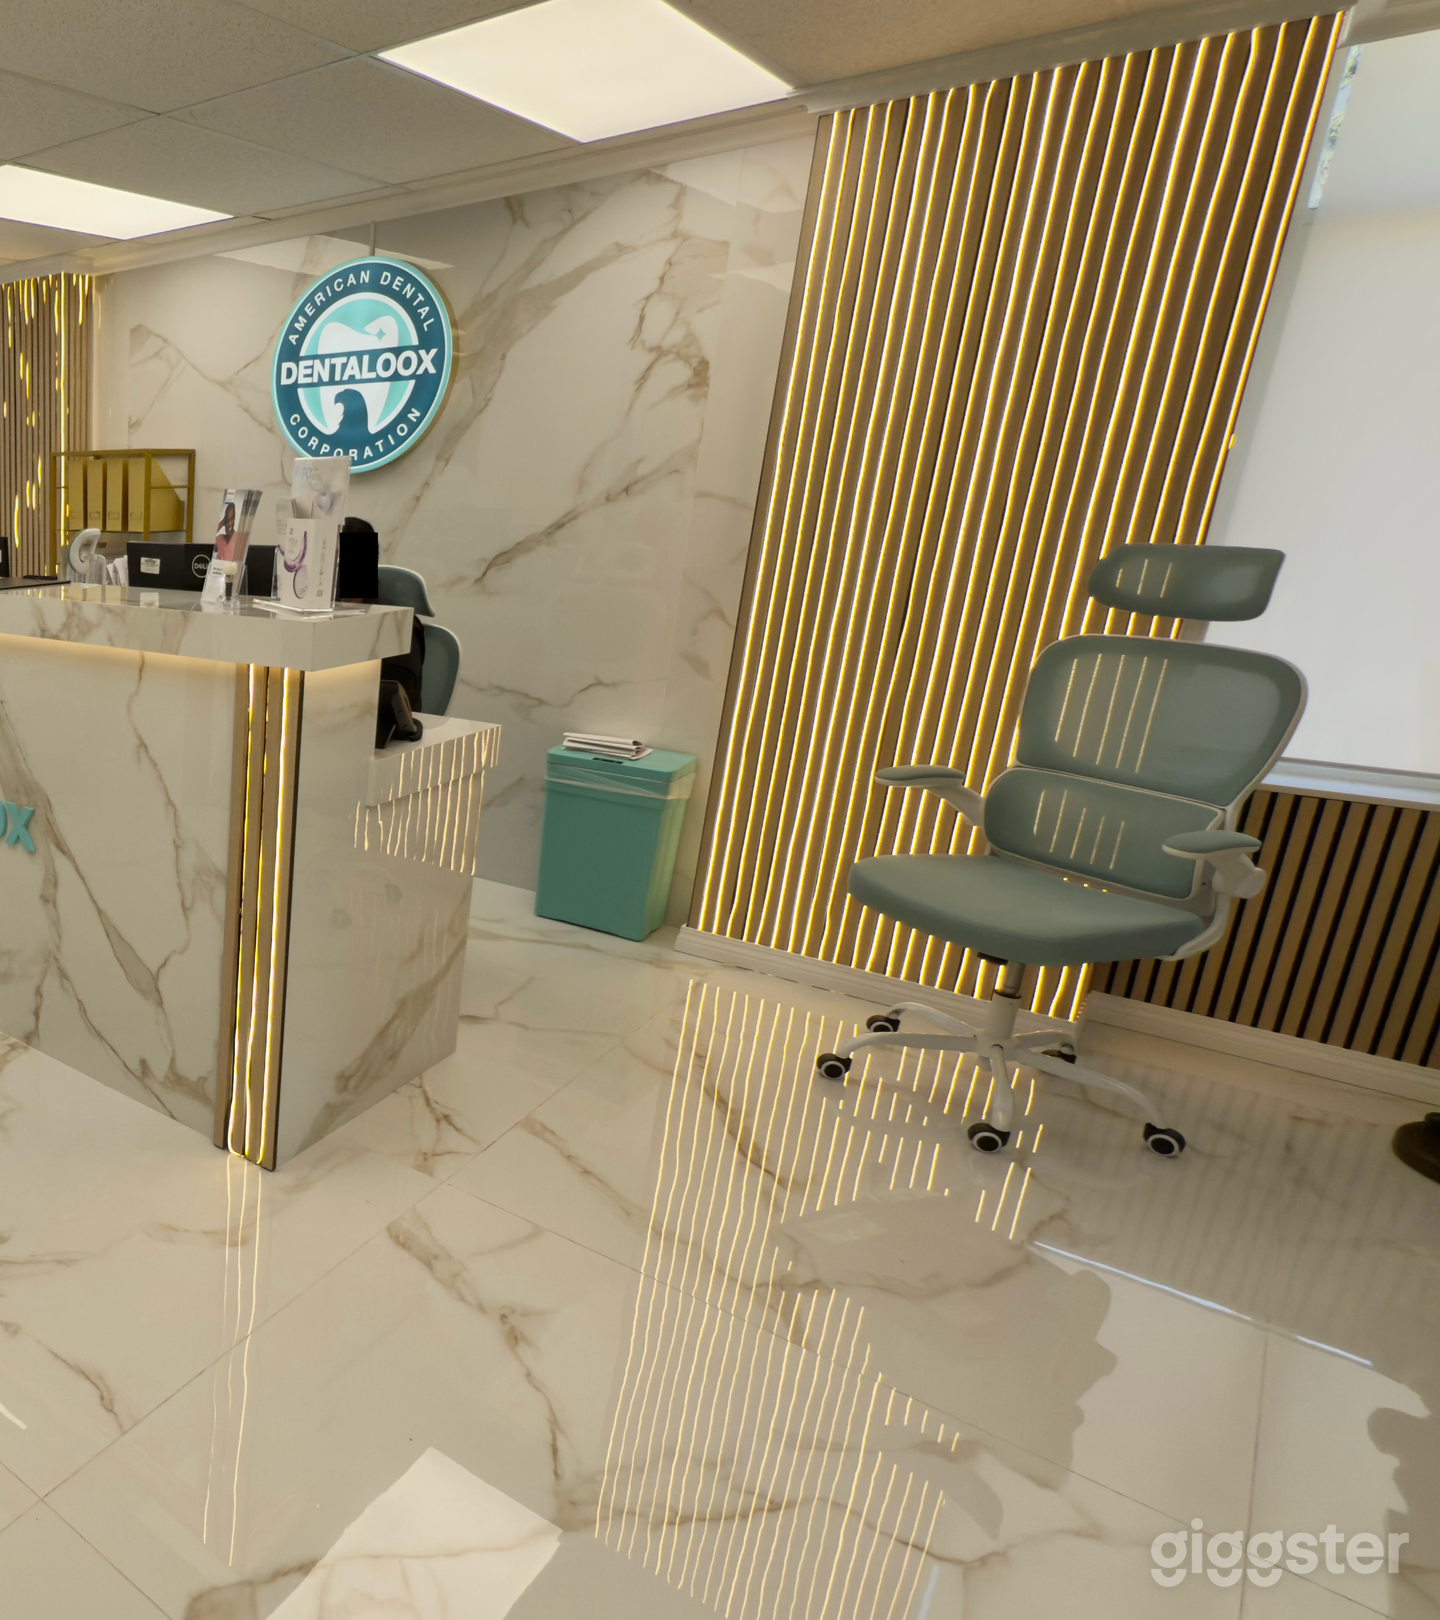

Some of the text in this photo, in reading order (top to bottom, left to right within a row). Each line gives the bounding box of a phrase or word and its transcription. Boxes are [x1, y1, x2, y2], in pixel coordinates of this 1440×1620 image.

[288, 270, 436, 346] AMERICAN DENTAL
[280, 347, 439, 386] DENTALOOX
[289, 407, 422, 462] CORPORATION
